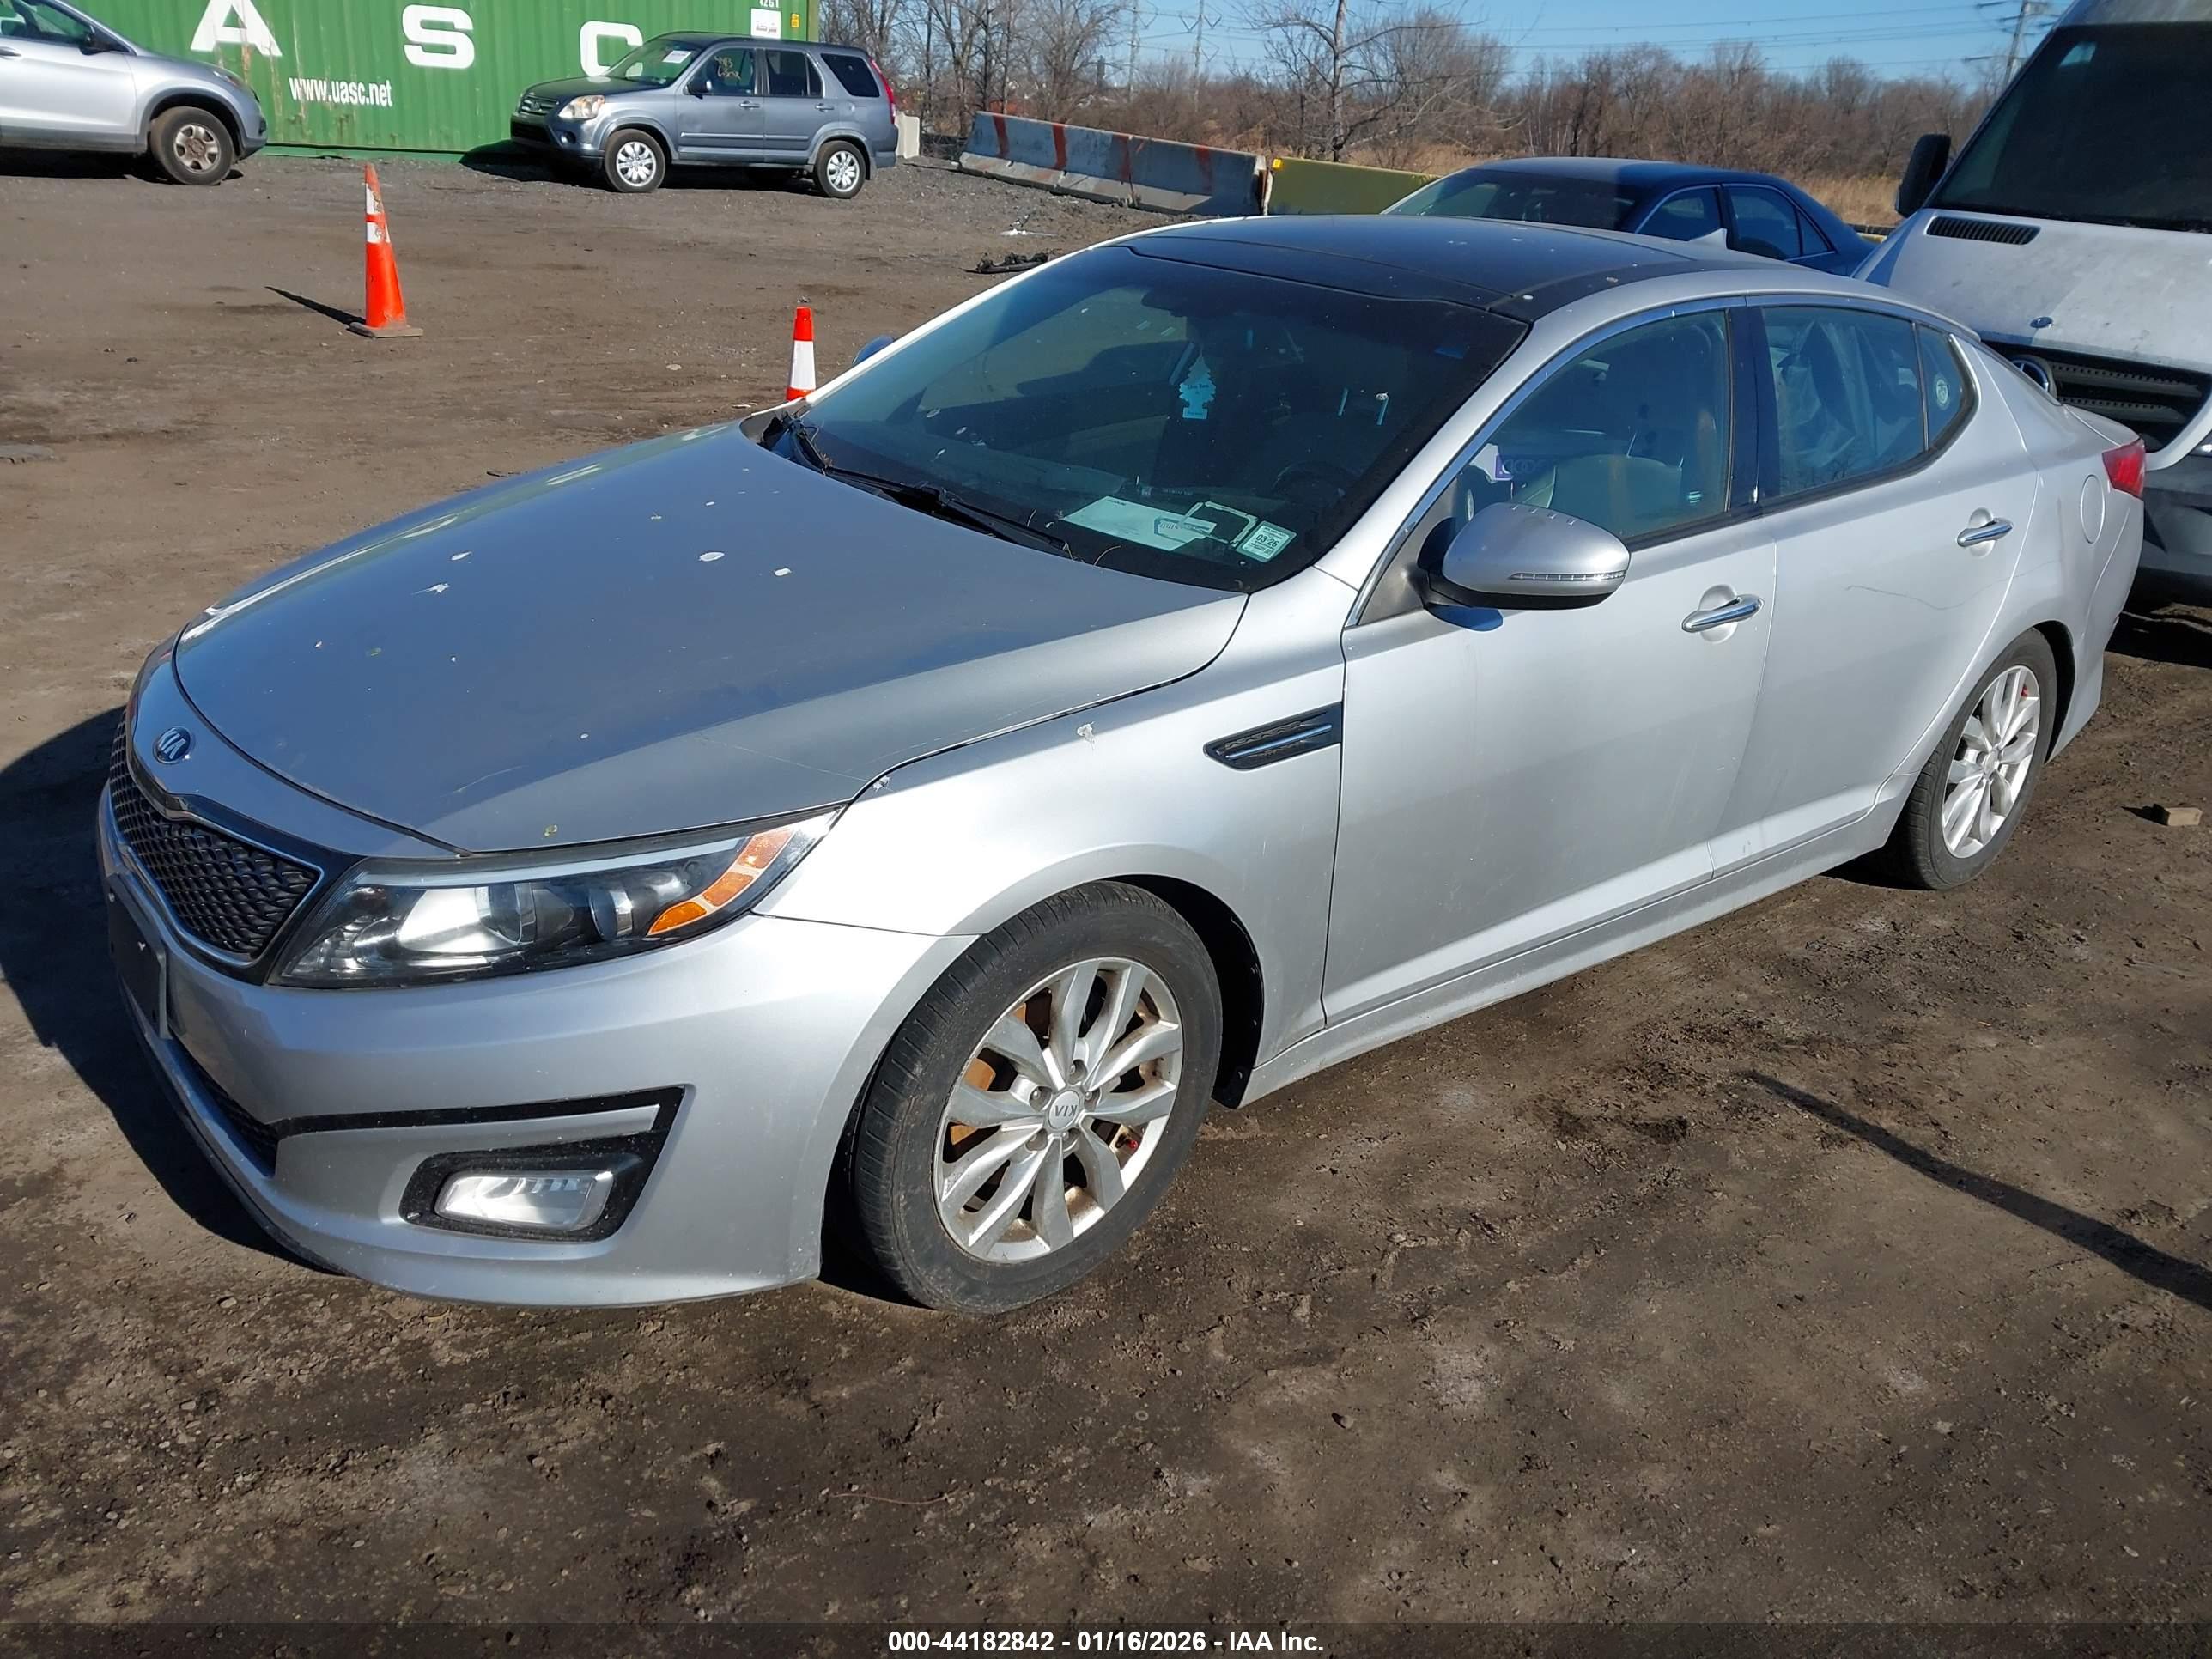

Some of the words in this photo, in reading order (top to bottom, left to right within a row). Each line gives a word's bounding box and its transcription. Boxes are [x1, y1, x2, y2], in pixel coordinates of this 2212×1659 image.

[191, 0, 282, 56] A
[402, 4, 475, 69] S
[289, 77, 393, 107] www.uasc.net
[1055, 1105, 1078, 1116] KIA
